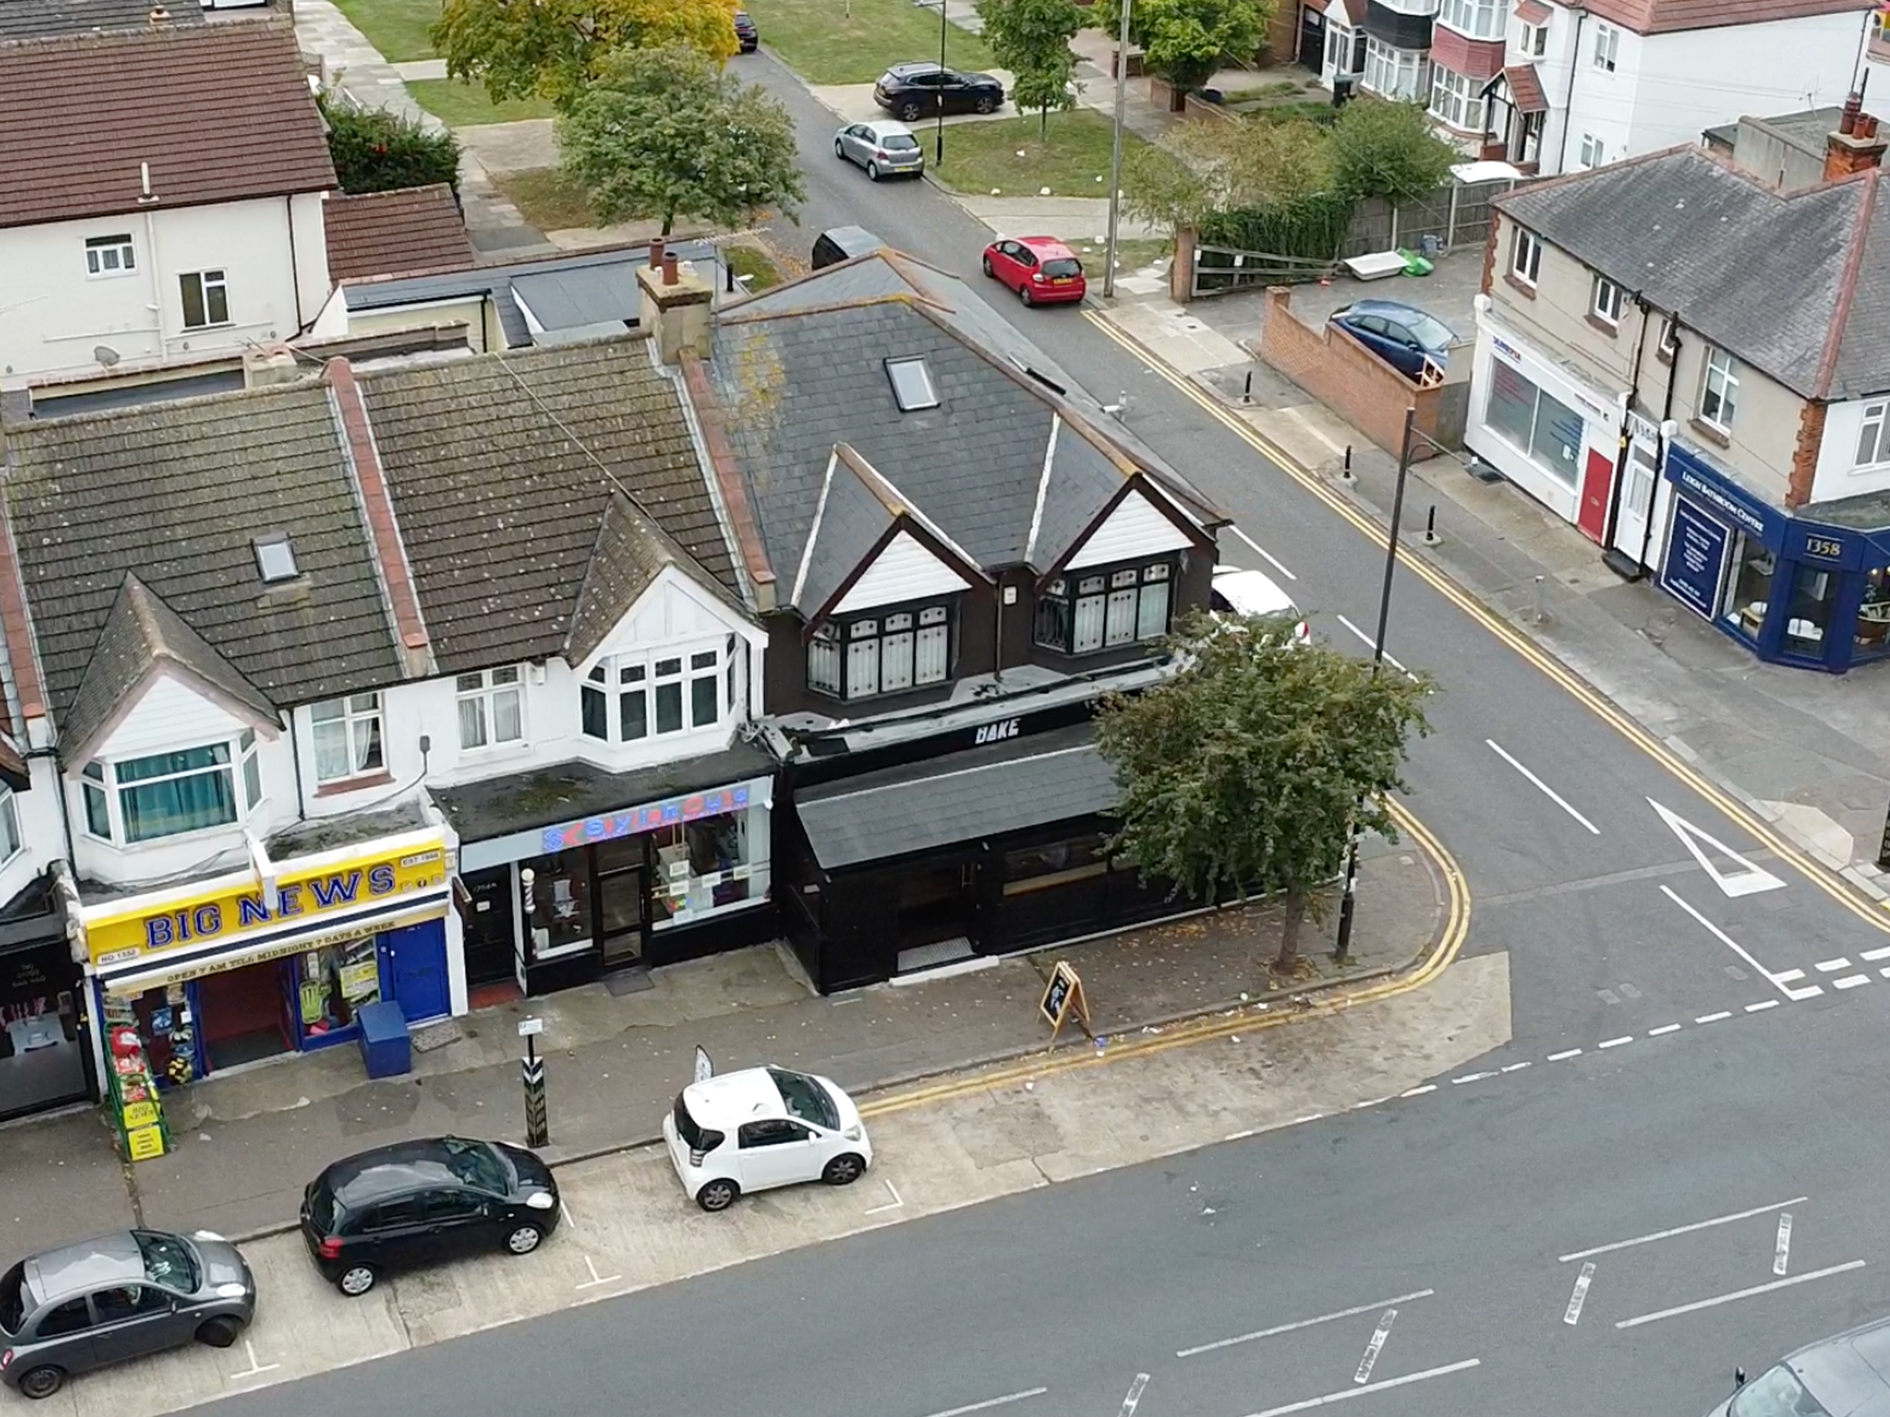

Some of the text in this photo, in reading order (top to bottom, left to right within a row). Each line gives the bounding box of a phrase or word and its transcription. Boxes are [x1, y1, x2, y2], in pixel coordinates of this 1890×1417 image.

[1806, 537, 1841, 556] 1358
[145, 864, 396, 949] BIG NEWS
[167, 969, 196, 983] OPEN
[209, 962, 227, 972] AM
[229, 956, 254, 968] TILL
[257, 940, 314, 961] MIDNIGHT
[324, 932, 351, 944] DAYS
[363, 920, 396, 933] WEEK
